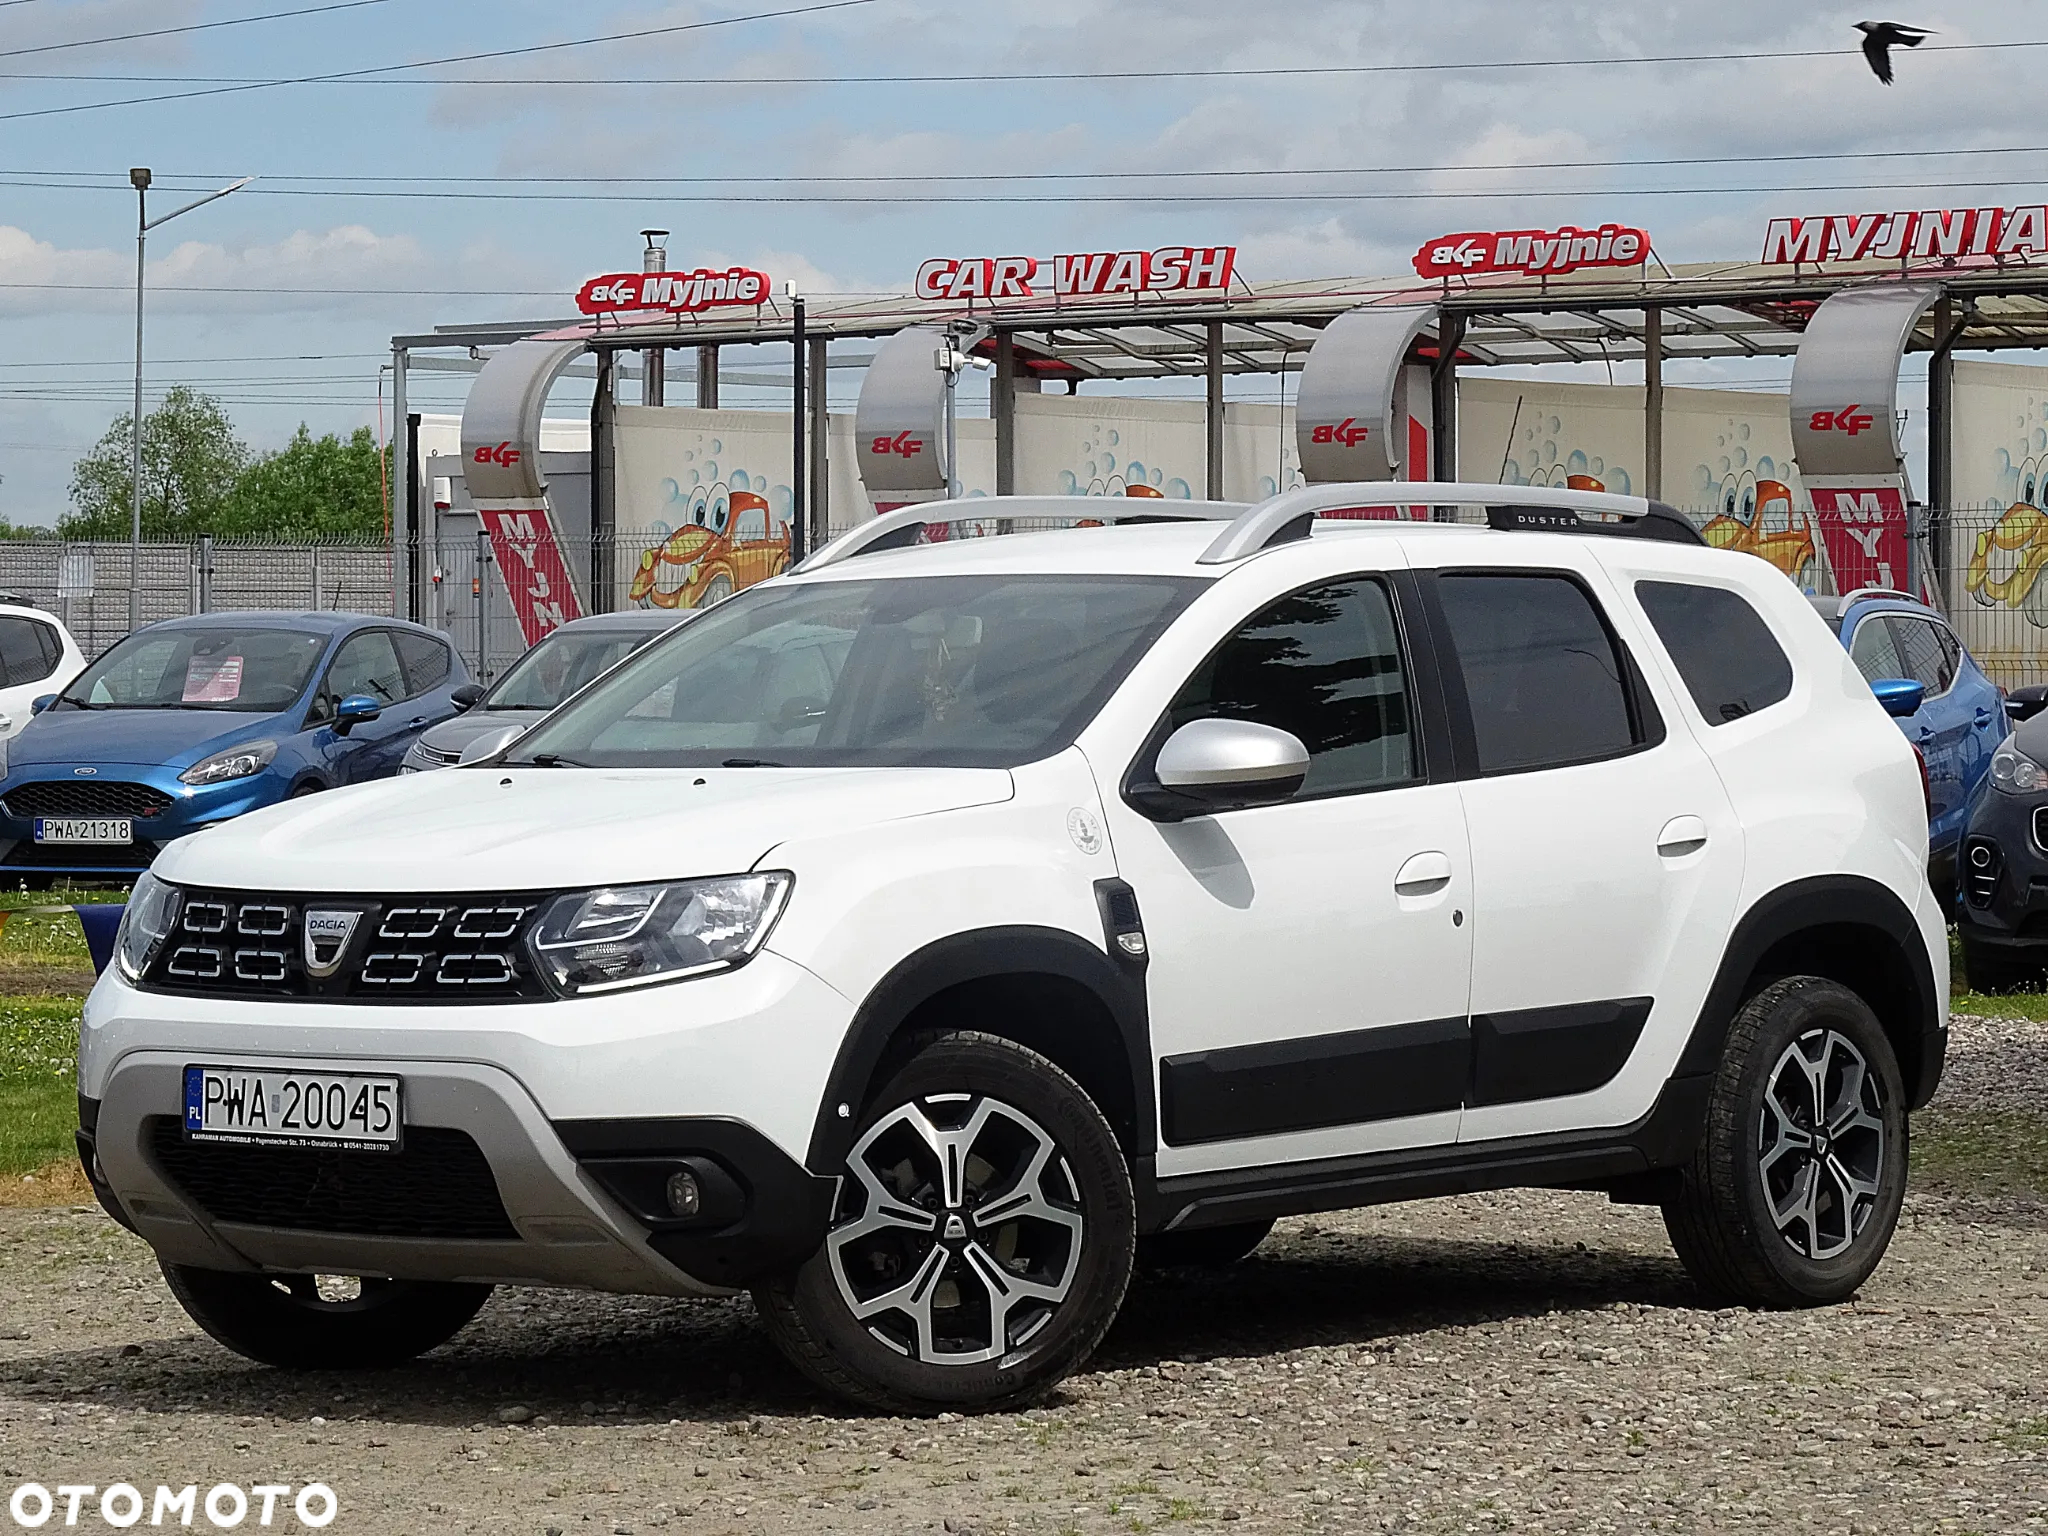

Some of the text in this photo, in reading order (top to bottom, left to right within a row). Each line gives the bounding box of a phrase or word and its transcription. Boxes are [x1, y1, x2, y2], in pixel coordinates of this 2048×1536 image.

[1493, 230, 1639, 269] Myjnie
[1761, 205, 2048, 264] MYJNIA
[641, 273, 760, 308] Myjnie
[915, 247, 1236, 300] CAR WASH
[1517, 515, 1578, 526] DUSTER
[44, 820, 75, 839] PWA
[79, 820, 129, 839] 21318
[310, 920, 346, 930] DACIA
[189, 1076, 392, 1133] PL PWA 20045
